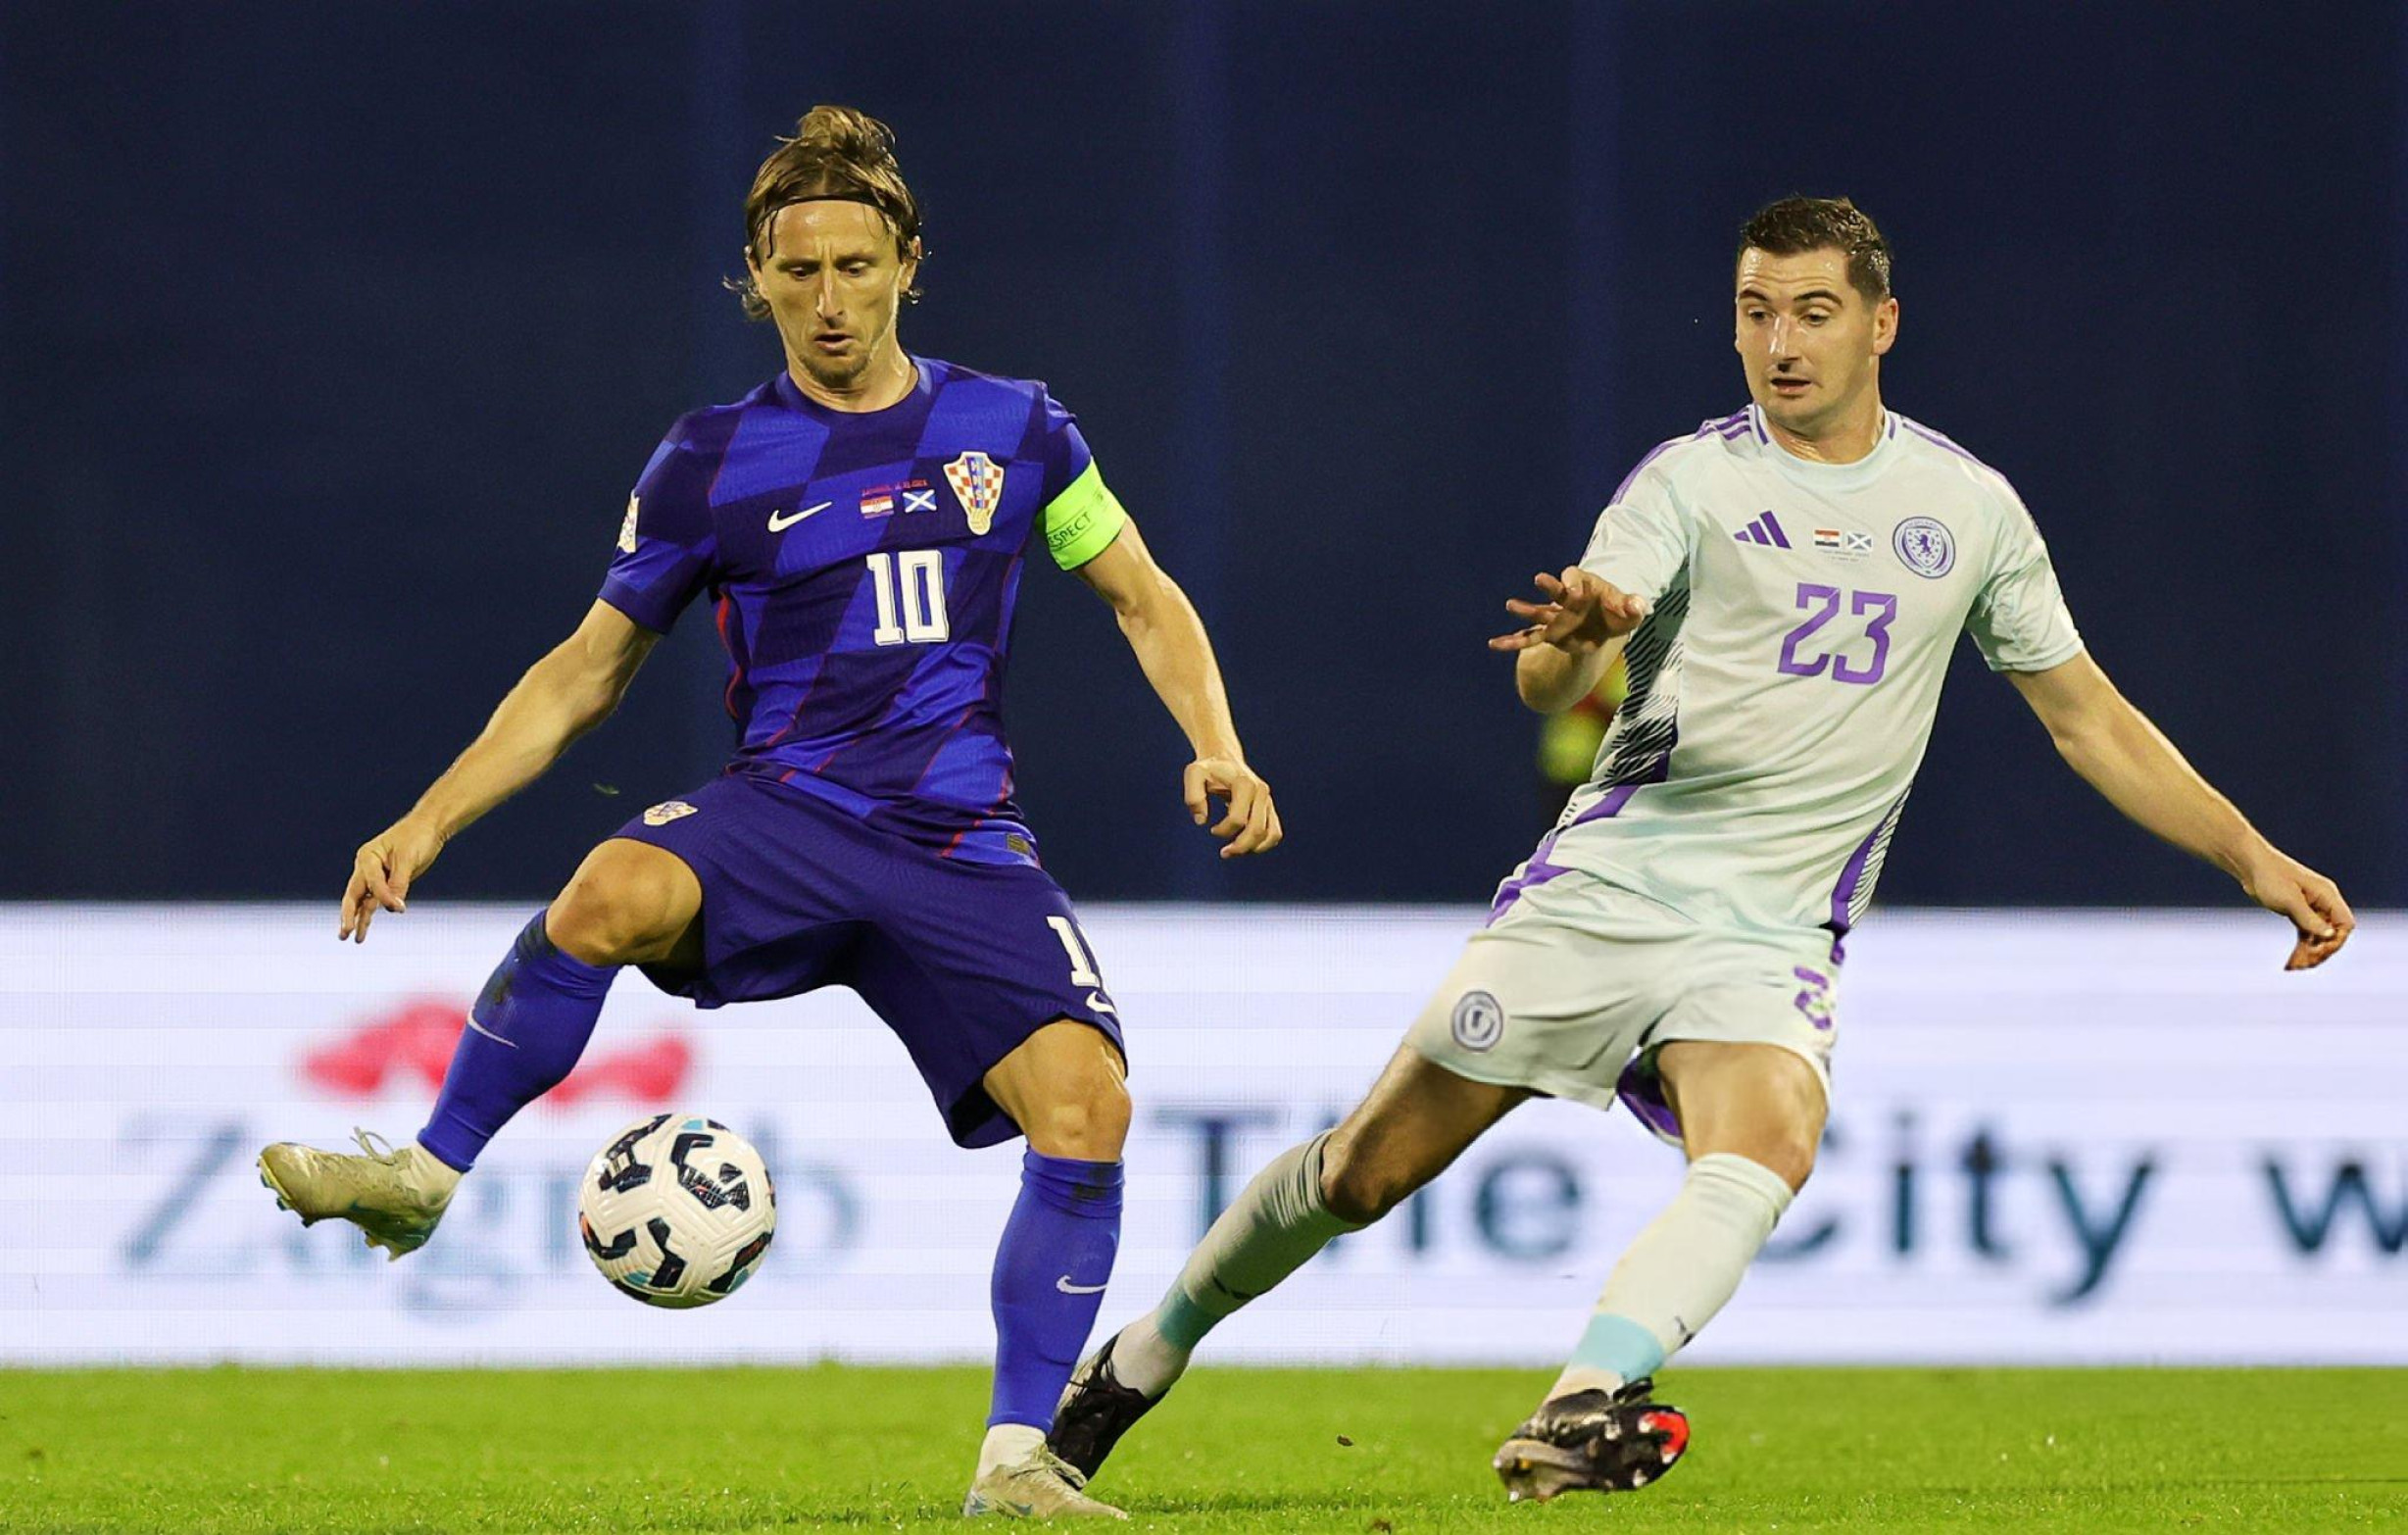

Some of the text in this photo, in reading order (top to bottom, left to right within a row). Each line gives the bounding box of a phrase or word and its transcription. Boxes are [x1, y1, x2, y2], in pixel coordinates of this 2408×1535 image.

[1048, 511, 1091, 547] ESPECT
[865, 549, 950, 647] 10
[1777, 582, 1897, 684] 23
[1046, 916, 1107, 992] 1
